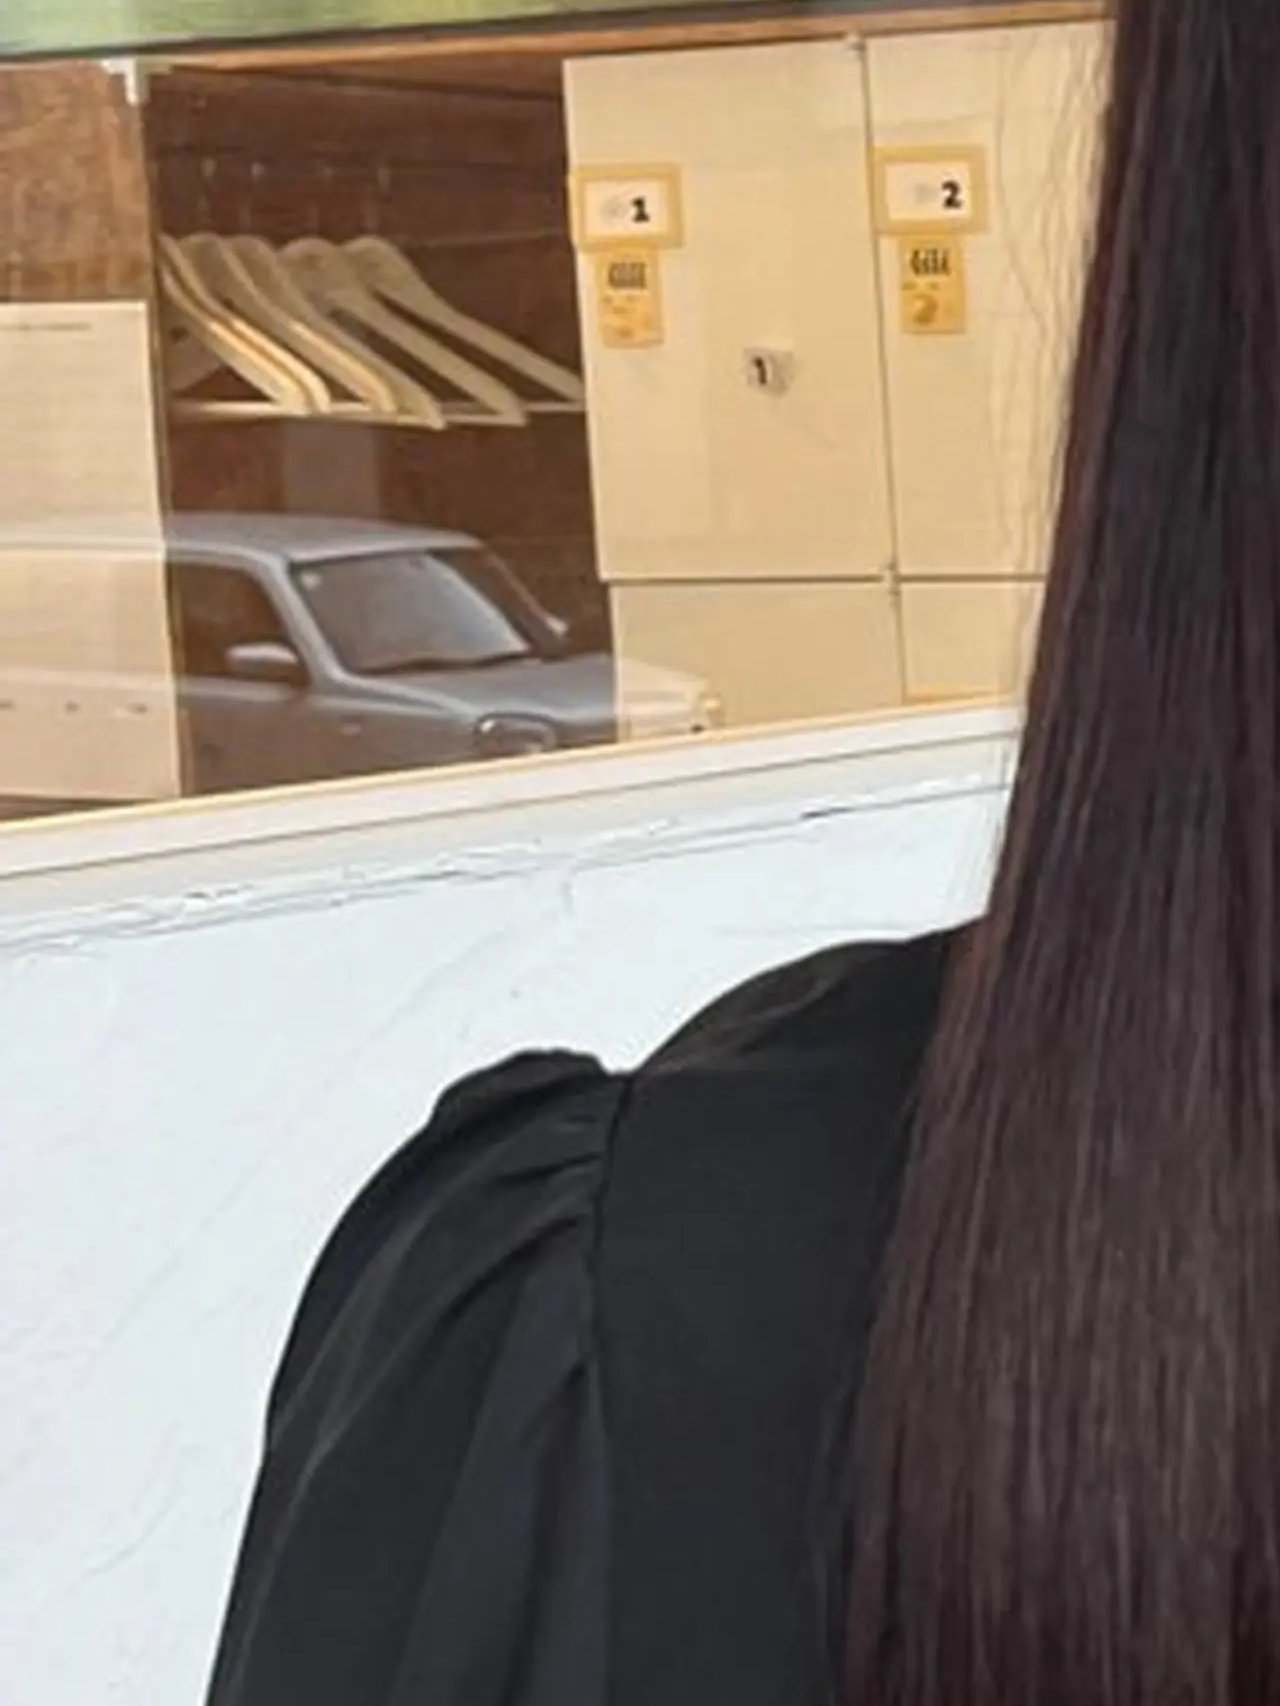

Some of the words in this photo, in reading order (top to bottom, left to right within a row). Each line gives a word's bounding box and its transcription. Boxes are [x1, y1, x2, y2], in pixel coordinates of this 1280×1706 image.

[941, 181, 963, 208] 2
[631, 197, 650, 223] 1
[751, 357, 768, 386] 1
